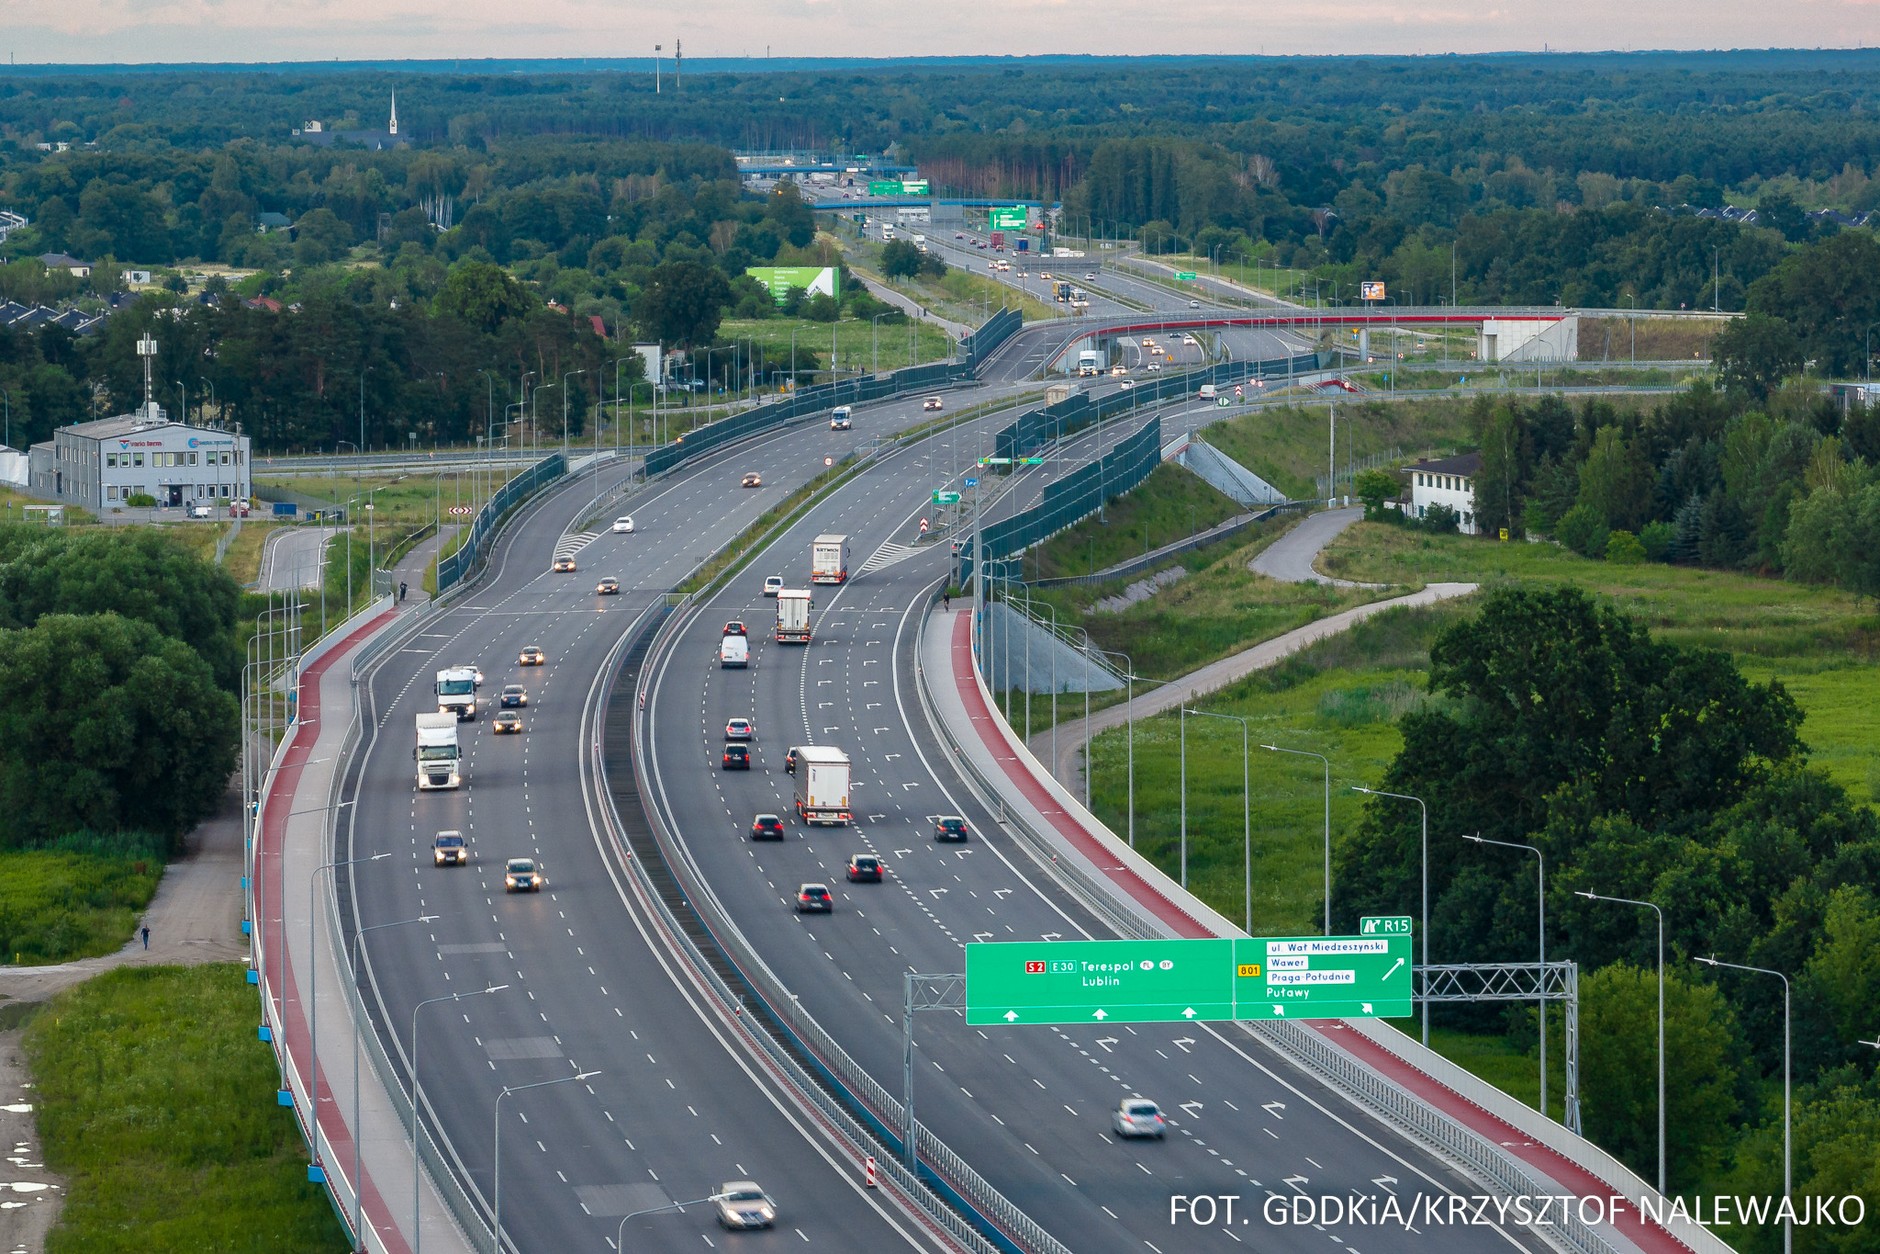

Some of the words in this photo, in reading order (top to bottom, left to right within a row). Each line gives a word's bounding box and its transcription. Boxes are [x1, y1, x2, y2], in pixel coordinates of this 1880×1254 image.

[1384, 919, 1409, 932] R15
[1287, 943, 1308, 952] Wał
[1081, 960, 1134, 974] Terespol
[1271, 958, 1304, 967] Wawer
[1240, 966, 1259, 976] 801
[1081, 975, 1120, 987] Lublin
[1271, 972, 1351, 984] Praga-Południe
[1266, 987, 1310, 1000] Puławy
